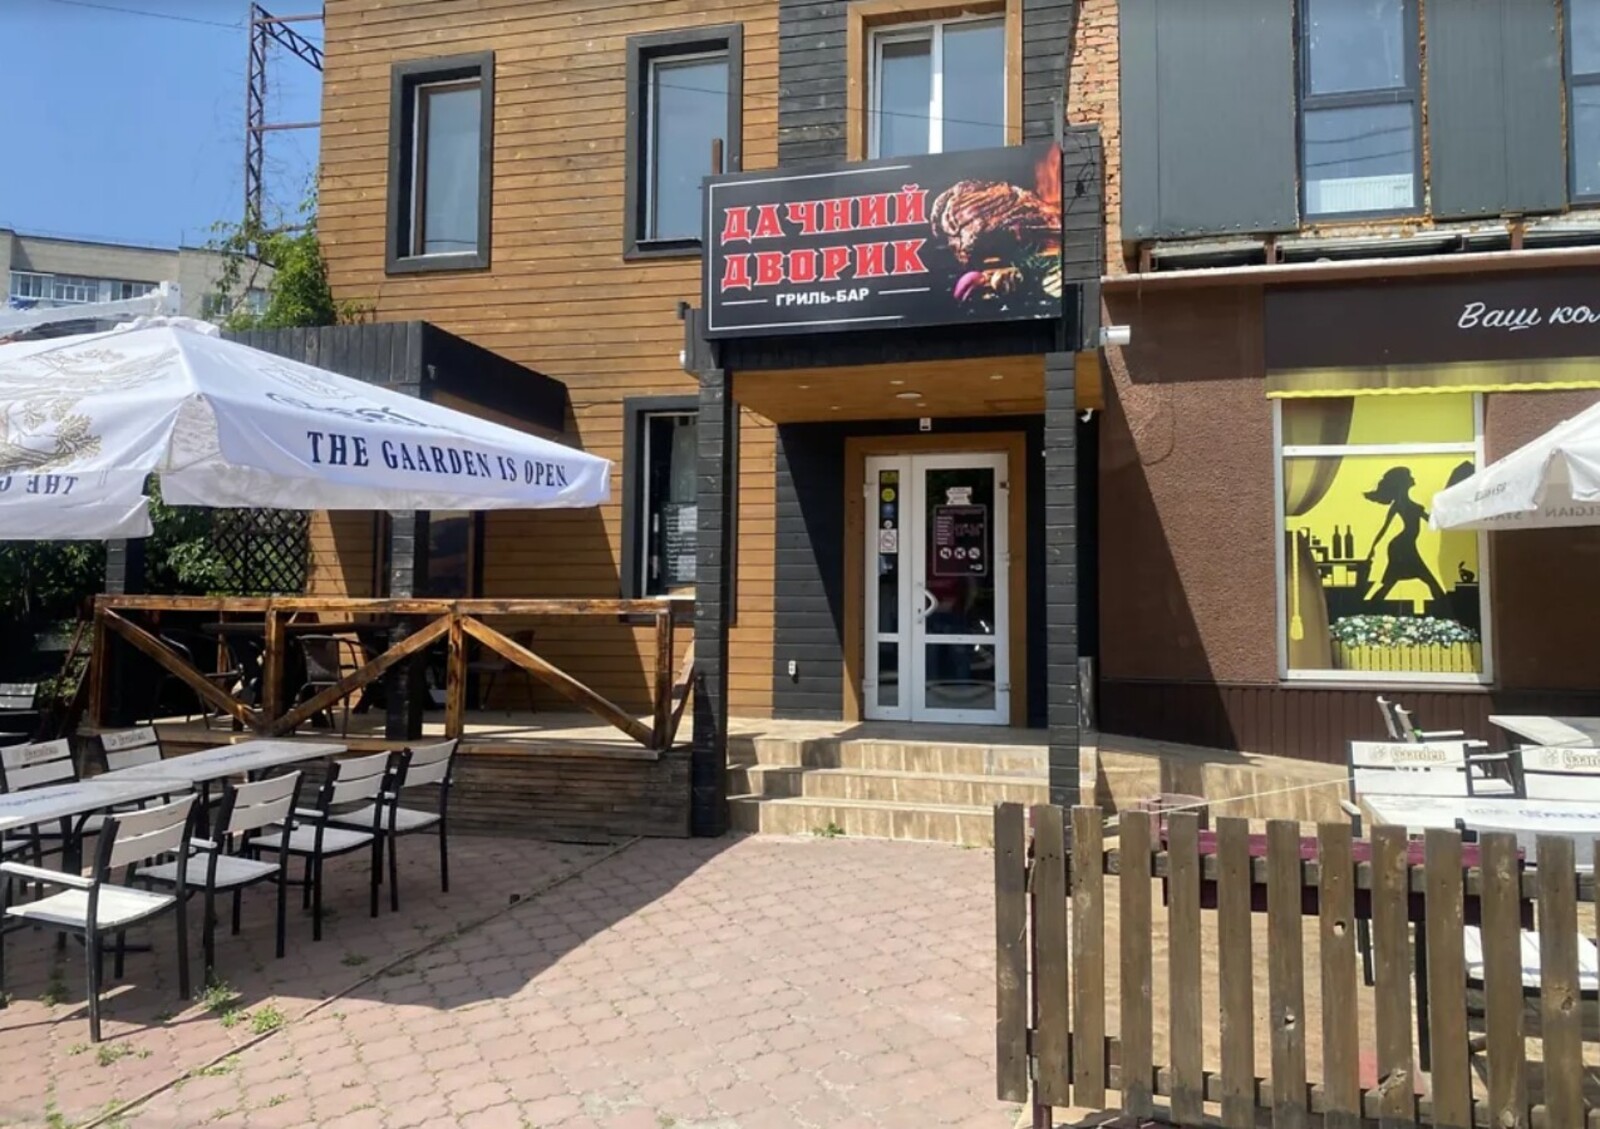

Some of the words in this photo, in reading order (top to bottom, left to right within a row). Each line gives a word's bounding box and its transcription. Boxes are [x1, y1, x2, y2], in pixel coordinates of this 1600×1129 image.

[720, 183, 930, 247] ДАЧНИЙ
[720, 238, 930, 294] ДВОРИК
[776, 287, 870, 306] ГРИЛЬ-БАР
[1457, 301, 1542, 332] Ваш
[307, 431, 369, 467] THE
[381, 440, 492, 478] GAARDEN
[497, 455, 518, 481] IS
[524, 459, 569, 487] OPEN
